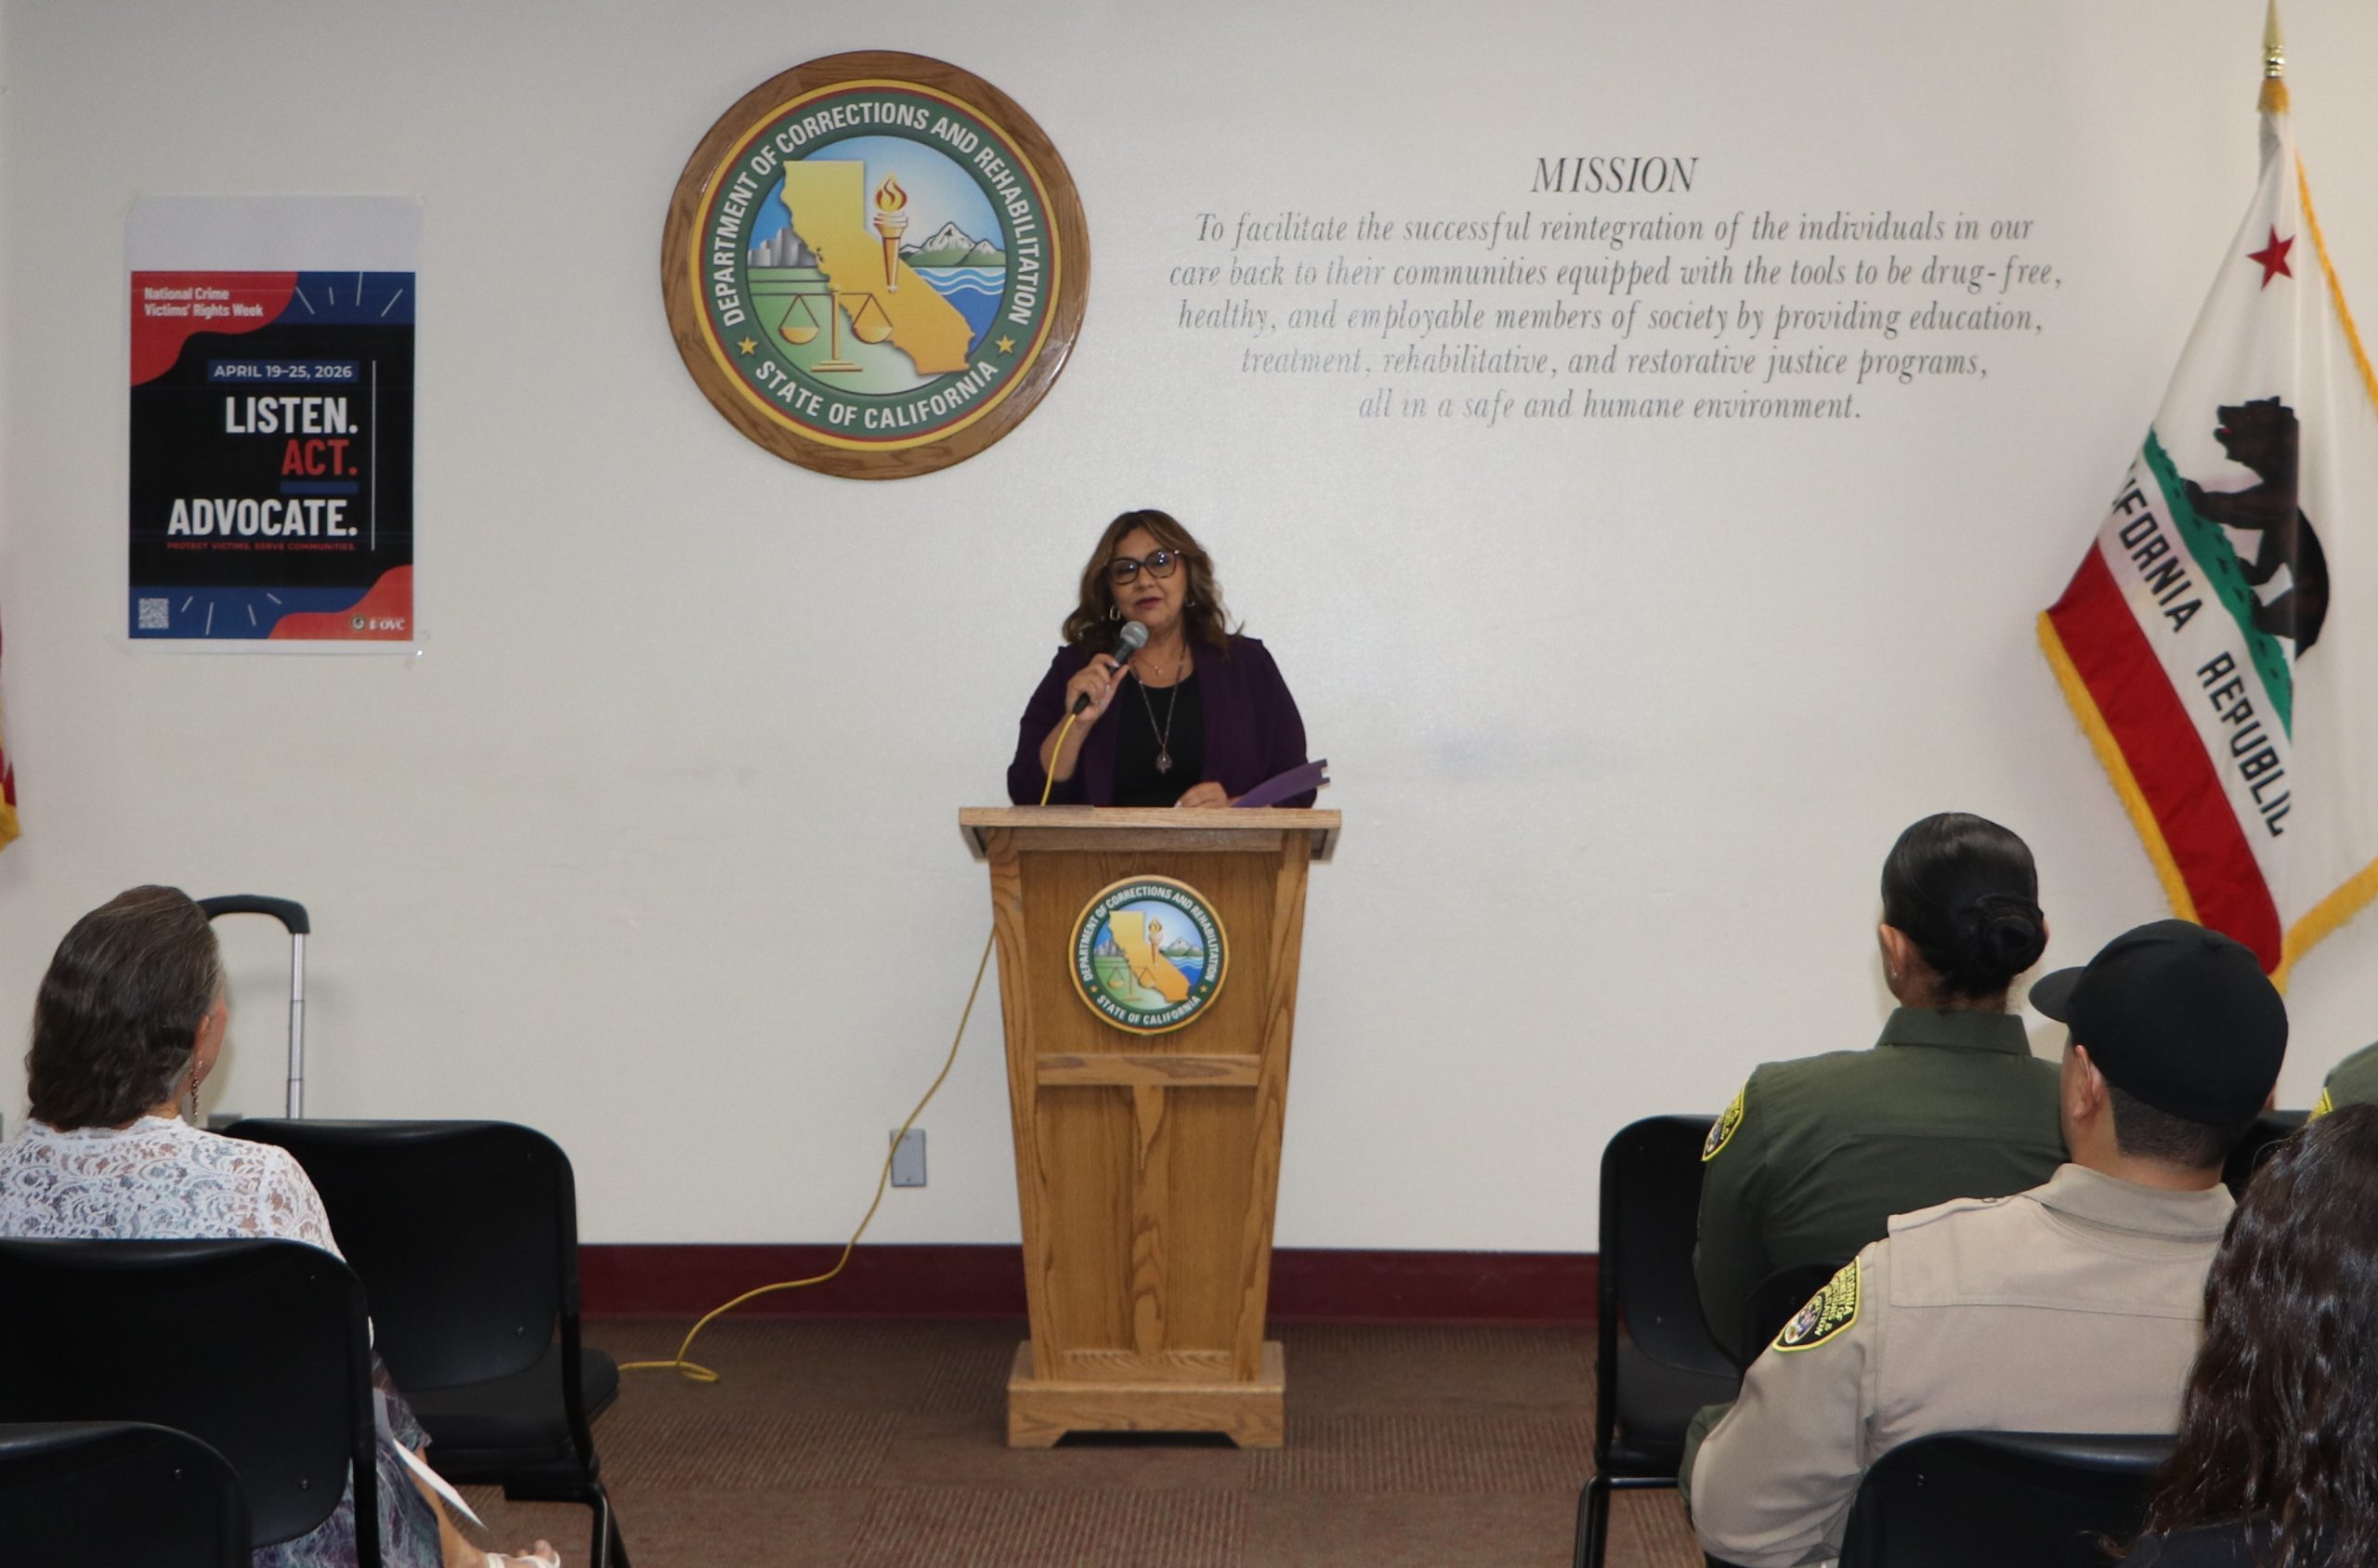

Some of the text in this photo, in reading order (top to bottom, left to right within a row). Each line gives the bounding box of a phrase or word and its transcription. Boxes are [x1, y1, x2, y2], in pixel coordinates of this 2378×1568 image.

[1531, 156, 1699, 193] MISSION
[713, 102, 1040, 327] DEPARTMENT OF CORRECTIONS AND REHABILITATION
[1196, 211, 2034, 251] To facilitate the successful reintegration of the individuals in our
[144, 287, 229, 300] National Crime
[1169, 255, 2062, 295] care back to their communities equipped with the tools to be drug-free,
[193, 304, 230, 320] Rights
[232, 304, 263, 317] Week
[1178, 299, 2043, 340] healthy, and employable members of society by providing education,
[214, 364, 262, 378] APRIL
[314, 365, 353, 378] 2026
[1241, 344, 1987, 384] treatment, rehabilitative, and restorative justice programs,
[756, 359, 999, 429] STATE OF CALIFORNIA
[1359, 387, 1861, 427] all in a safe and humane environment.
[226, 397, 359, 434] LISTEN.
[281, 438, 358, 476] ACT.
[167, 499, 359, 537] ADVOCATE.
[166, 542, 208, 551] PROTECT
[255, 542, 285, 551] SERVE
[287, 542, 357, 551] COMMUNITIES.
[1078, 886, 1220, 982] DEPARTMENT OF CORRECTIONS AND REHABILITATION
[1096, 995, 1201, 1025] STATE OF CALIFORNIA
